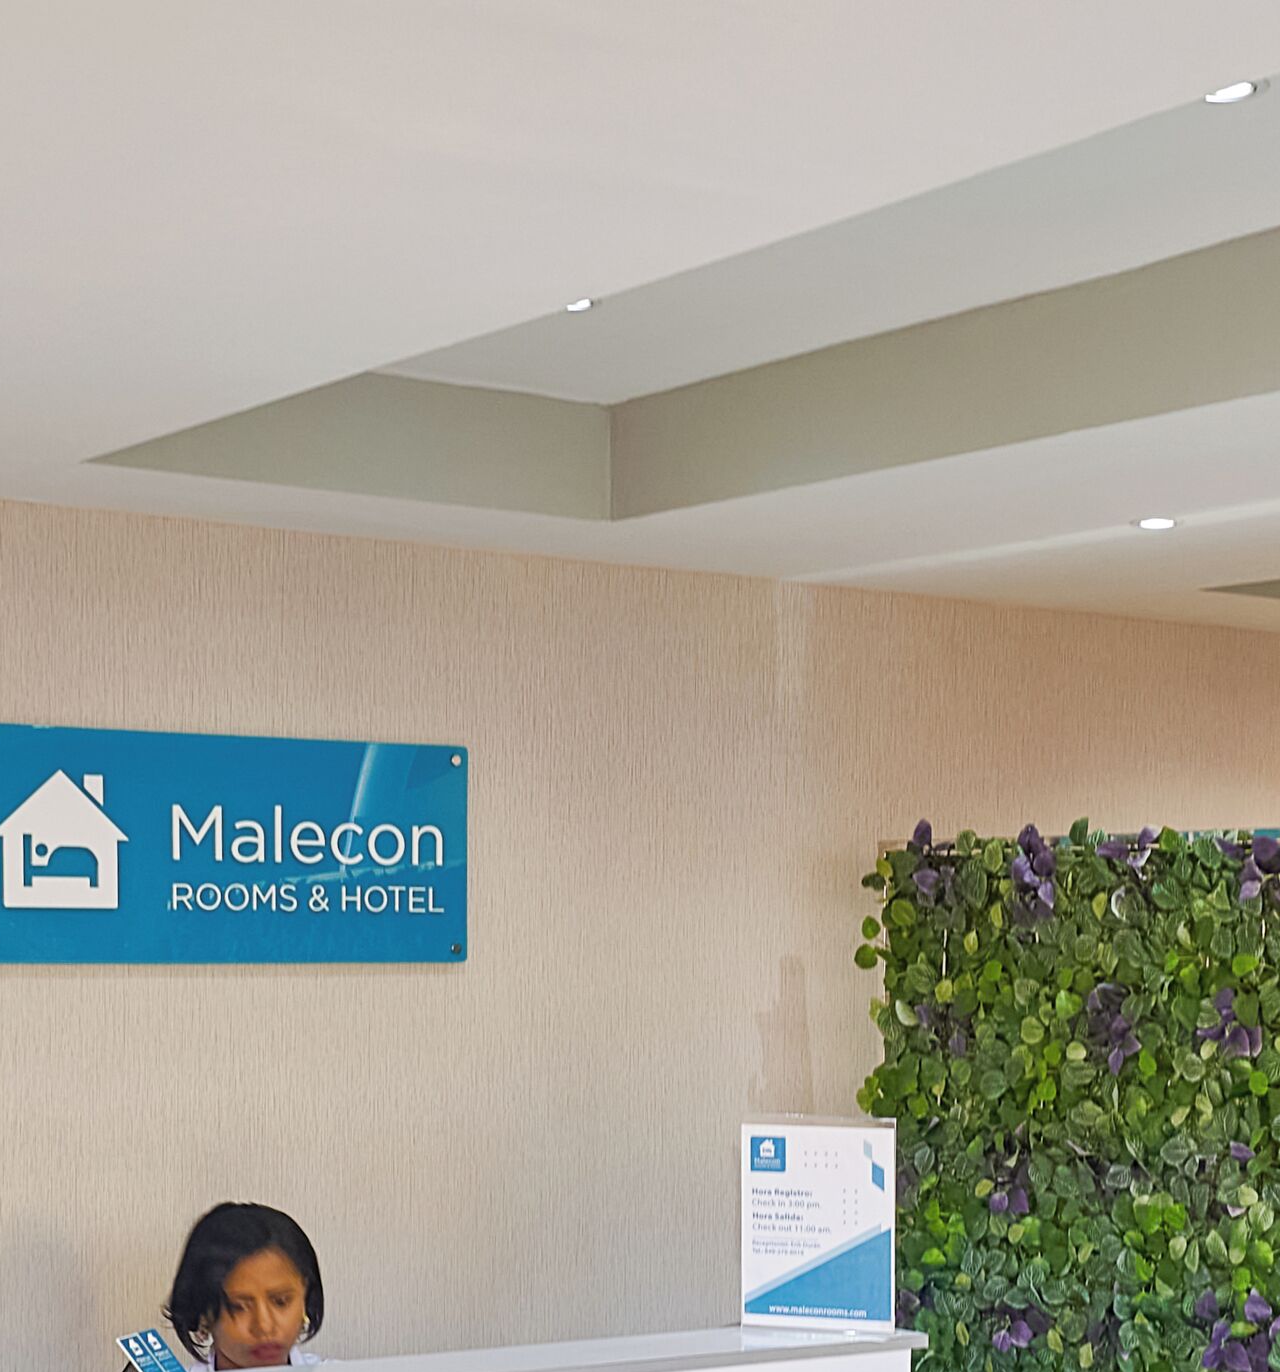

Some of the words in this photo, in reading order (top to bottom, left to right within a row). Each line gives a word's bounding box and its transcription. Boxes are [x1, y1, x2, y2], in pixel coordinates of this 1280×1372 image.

[171, 803, 444, 867] Malecon
[171, 882, 298, 913] ROOMS
[309, 884, 329, 914] &
[341, 885, 445, 914] HOTEL
[751, 1187, 773, 1196] Hora
[751, 1198, 776, 1207] Check
[752, 1211, 773, 1220] Hora
[752, 1223, 776, 1232] Check
[778, 1224, 792, 1232] out
[768, 1304, 867, 1319] www.maleconrooms.com
